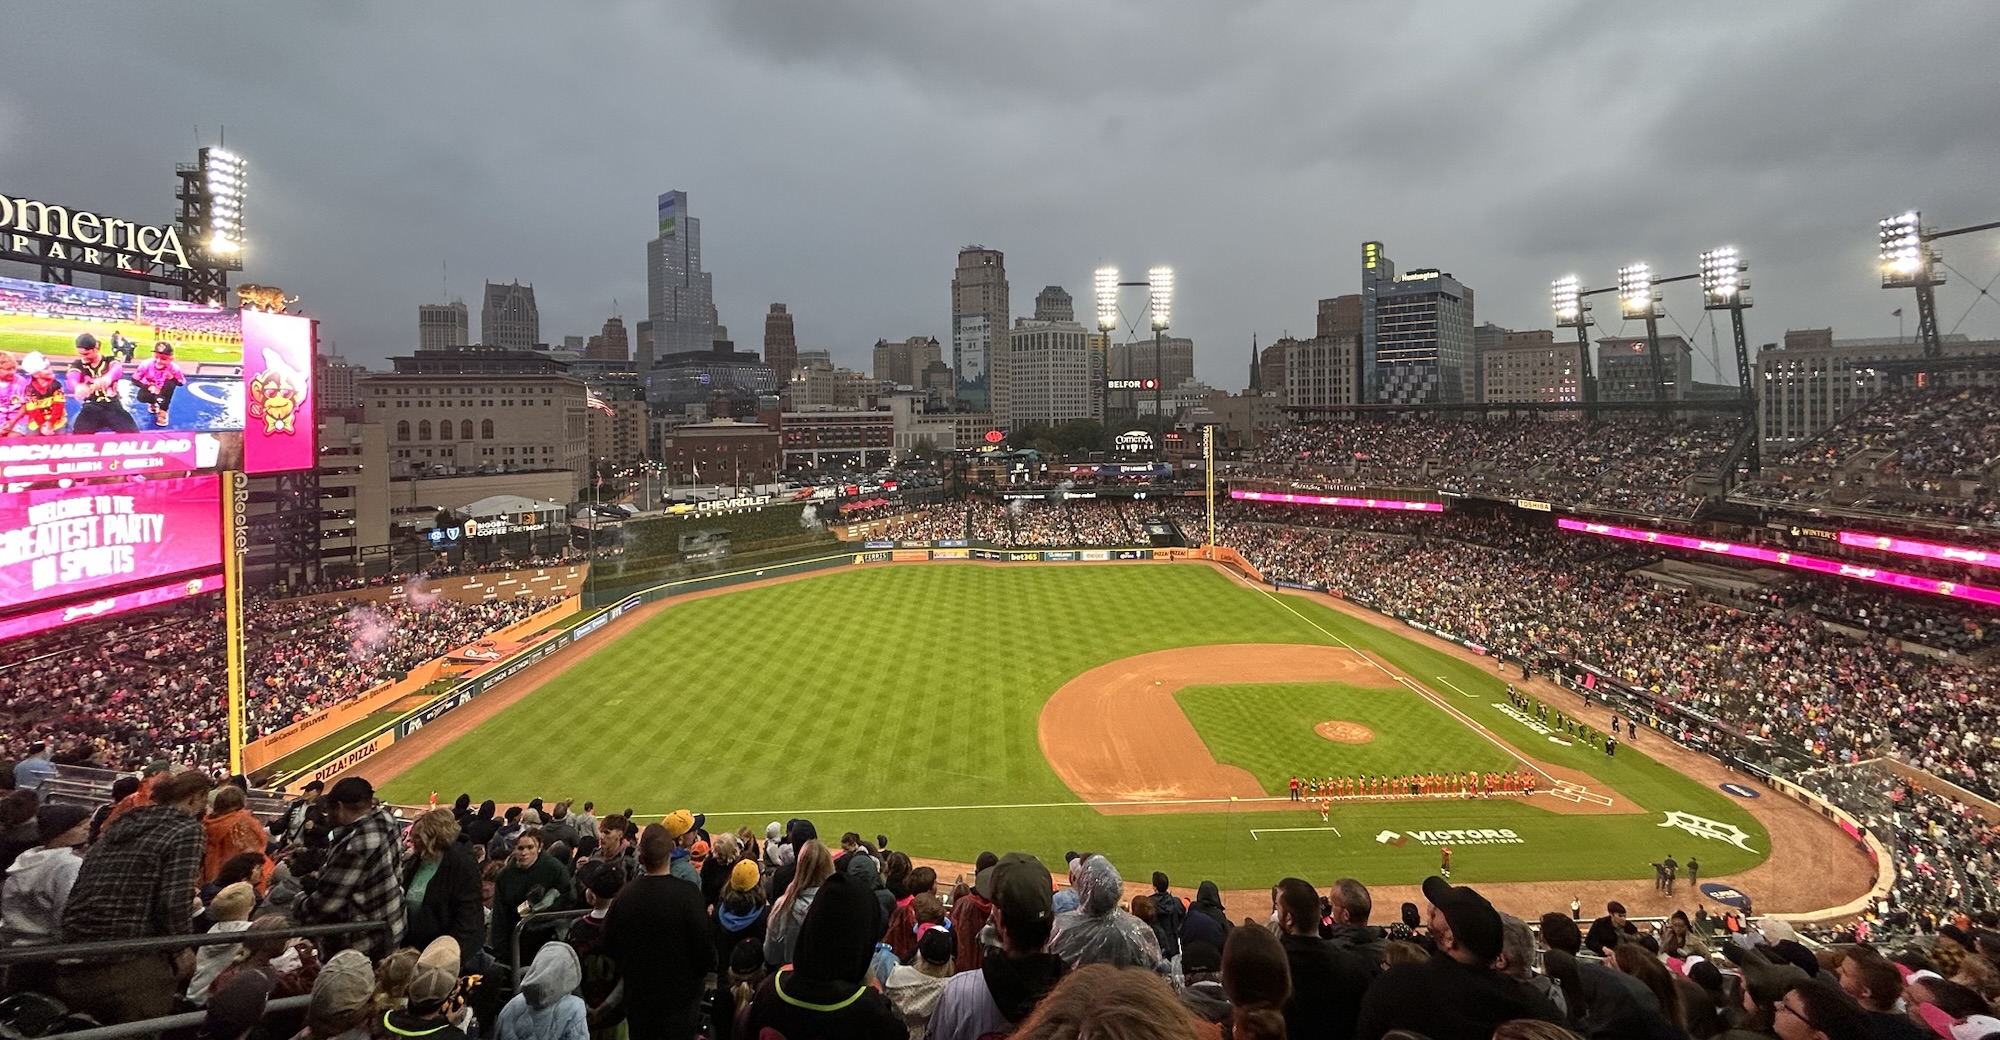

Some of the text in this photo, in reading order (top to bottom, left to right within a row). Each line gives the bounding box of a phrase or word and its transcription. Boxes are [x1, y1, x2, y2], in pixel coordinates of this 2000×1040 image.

[13, 234, 133, 270] PARK
[1401, 271, 1439, 282] Huntington
[1108, 380, 1141, 389] BELFOR
[100, 439, 191, 456] BALLARD
[698, 495, 772, 511] CHEVROLET
[1519, 500, 1549, 510] TOSHIBA
[28, 496, 135, 525] WELCOME TO THE
[683, 506, 762, 520] FOUNTAIN
[234, 489, 250, 556] Rocket
[477, 521, 507, 529] BIGGBY
[103, 514, 164, 546] PARTY
[477, 528, 507, 537] COFFEE
[1801, 528, 1837, 541] WINTER'S
[1010, 553, 1038, 561] bet365
[32, 545, 135, 591] IN SPORTS
[392, 586, 403, 594] 23
[300, 712, 330, 733] DELIVERY
[315, 741, 378, 782] PIZZA! PIZZA!
[1405, 829, 1518, 841] VICTORS
